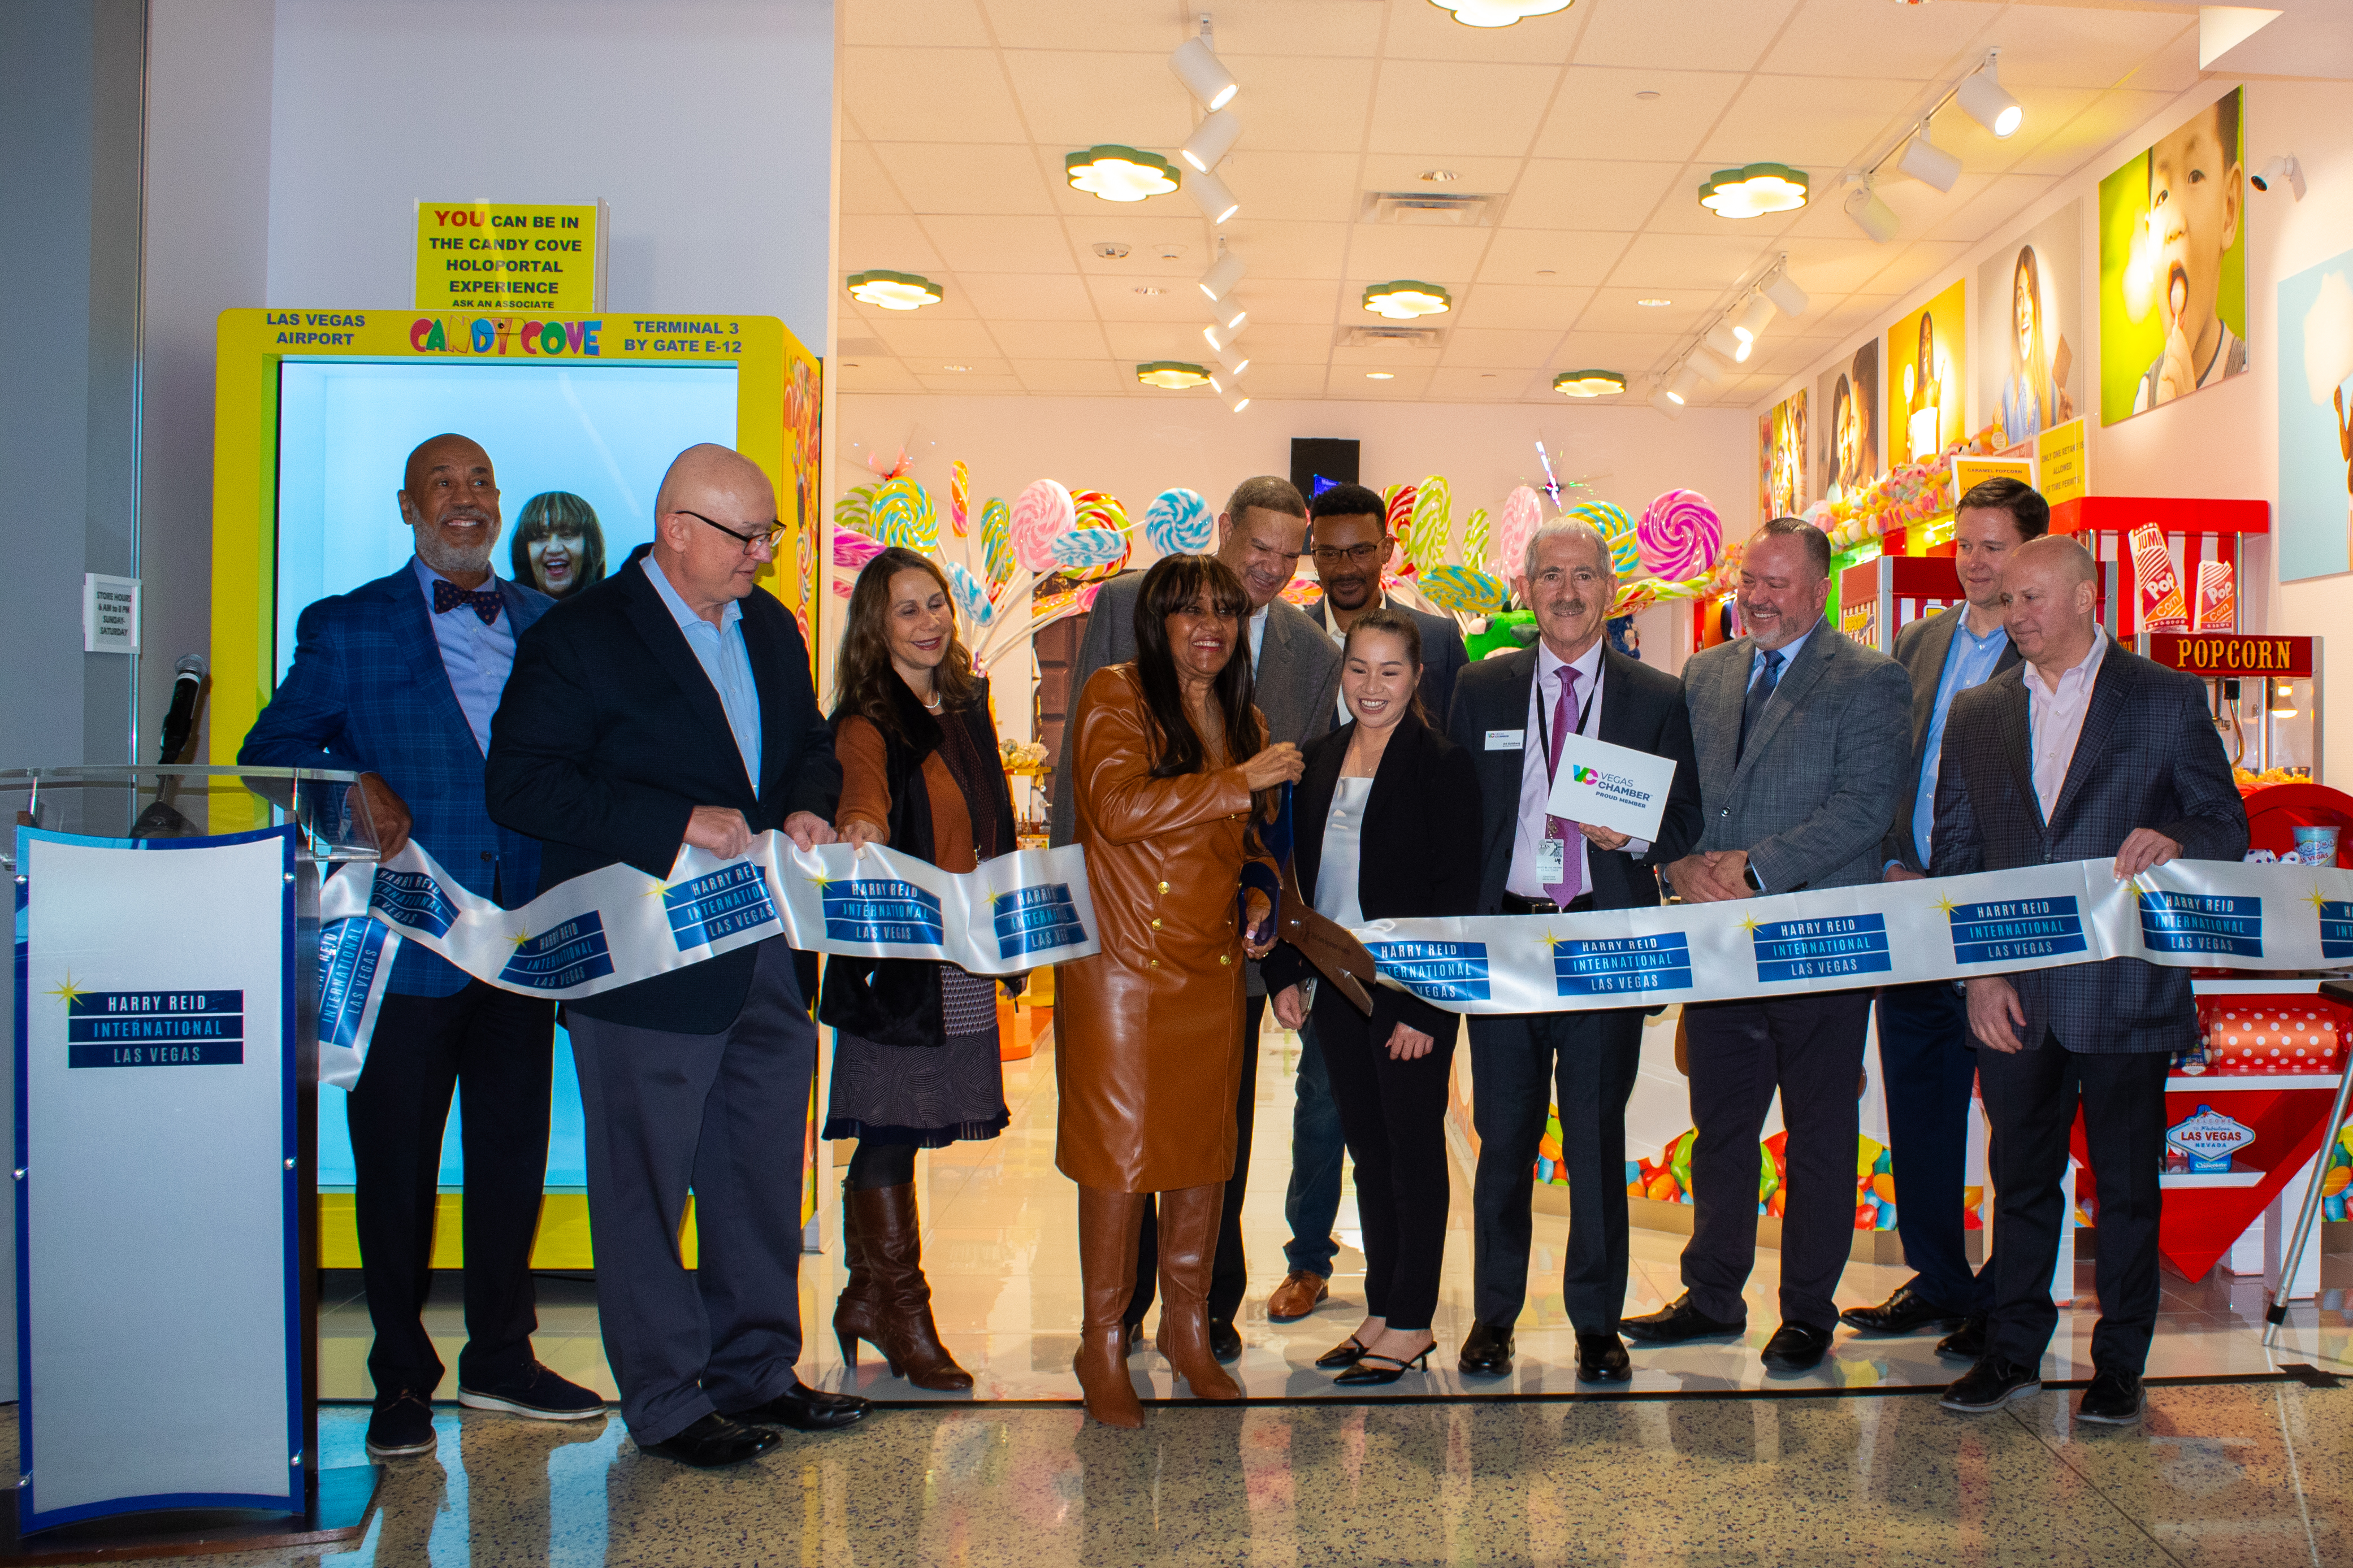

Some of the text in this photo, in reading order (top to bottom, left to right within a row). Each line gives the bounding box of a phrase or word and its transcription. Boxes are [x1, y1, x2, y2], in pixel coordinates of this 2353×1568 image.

[434, 211, 579, 228] YOU CAN BE IN
[429, 238, 582, 251] THE CANDY COVE
[447, 259, 563, 272] HOLOPORTAL
[449, 281, 558, 294] EXPERIENCE
[267, 314, 365, 327] LAS VEGAS
[634, 320, 739, 335] TERMINAL 3
[276, 332, 354, 345] AIRPORT
[410, 314, 603, 356] CANDY COVE
[625, 339, 742, 353] BY GATE E-12
[97, 591, 113, 600] STORE
[100, 627, 128, 636] SATURDAY
[2177, 639, 2291, 669] POPCORN
[1601, 772, 1633, 787] VEGAS
[1598, 781, 1650, 801] CHAMBER
[1596, 791, 1646, 809] PROUD MEMBER
[691, 872, 732, 896] HARRY
[852, 883, 917, 897] HARRY REID
[382, 901, 417, 923] VEGAS
[843, 903, 929, 919] INTERNATIONAL
[1977, 901, 2049, 918] HARRY REID
[2165, 895, 2234, 912] HARRY REID
[709, 904, 774, 937] LAS VEGAS
[1781, 919, 1855, 936] HARRY REID
[2155, 915, 2244, 933] INTERNATIONAL
[540, 922, 578, 950] HARRY REID
[856, 926, 911, 940] LAS VEGAS
[1970, 920, 2065, 939] INTERNATIONAL
[1031, 932, 1052, 948] LAS
[1582, 938, 1657, 952] HARRY REID
[1773, 937, 1871, 957] INTERNATIONAL
[2171, 936, 2233, 952] LAS VEGAS
[526, 941, 593, 970] INTERNATIONAL
[1381, 944, 1457, 958] HARRY REID
[1987, 941, 2053, 958] LAS VEGAS
[1573, 953, 1672, 972] INTERNATIONAL
[1791, 959, 1857, 976] LAS VEGAS
[322, 928, 362, 1023] INTERNATIONAL
[348, 949, 378, 1014] LAS VEGAS
[534, 966, 585, 987] LAS VEGAS
[1591, 974, 1658, 991] LAS VEGAS
[1416, 985, 1455, 998] VEGAS
[108, 995, 206, 1011] HARRY REID
[93, 1020, 222, 1037] INTERNATIONAL
[114, 1047, 200, 1063] LAS VEGAS
[2181, 1131, 2242, 1141] LAS VEGAS
